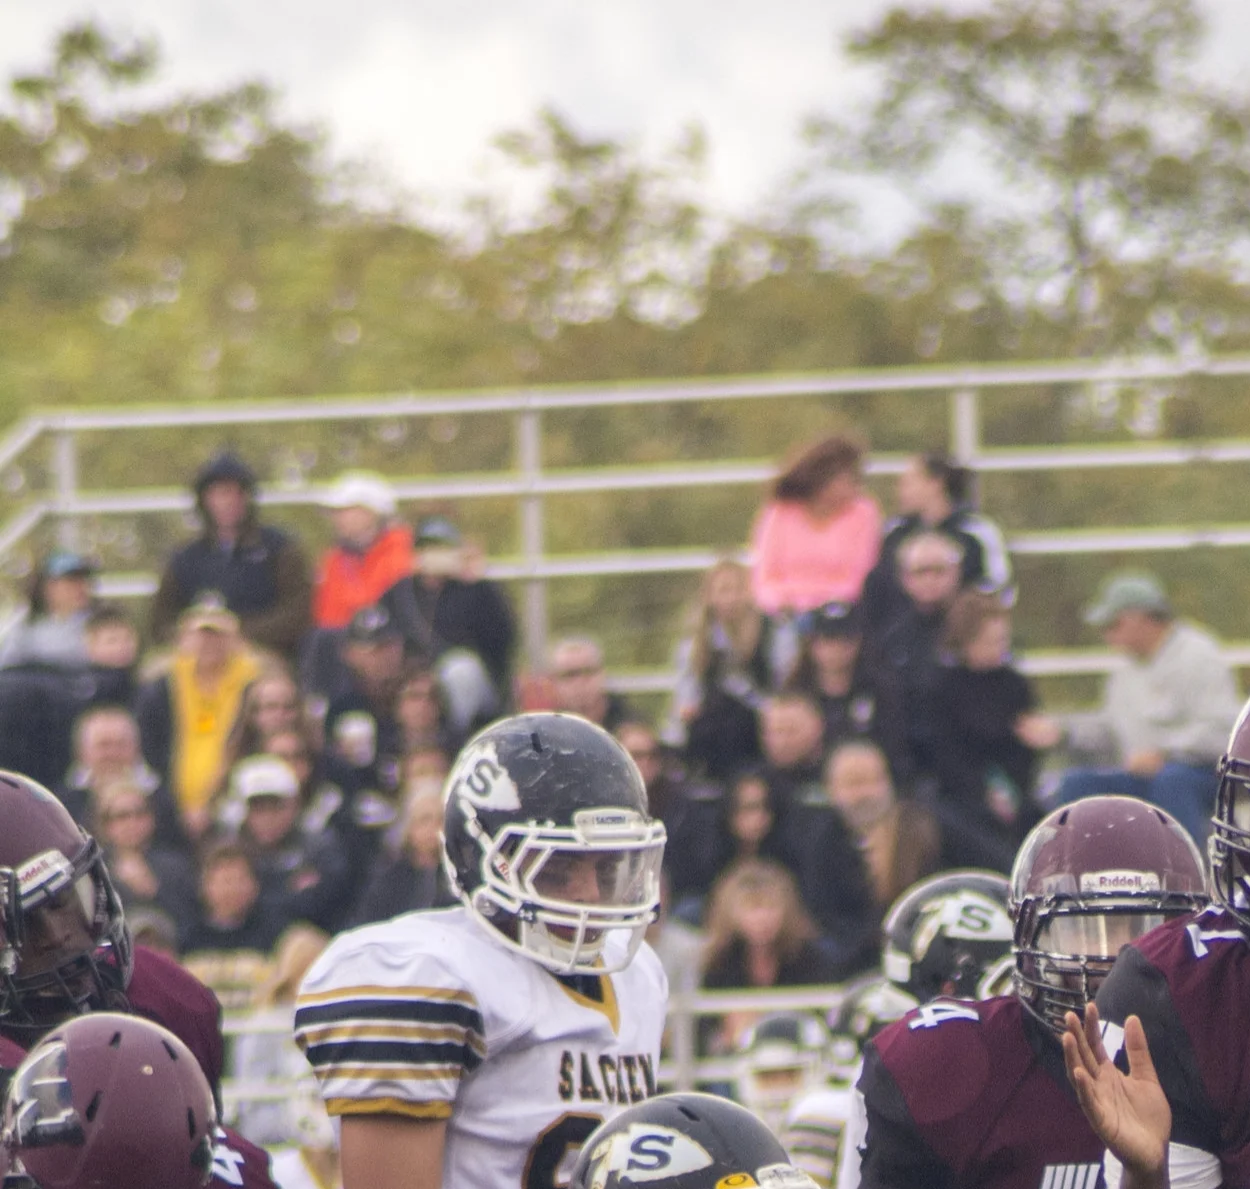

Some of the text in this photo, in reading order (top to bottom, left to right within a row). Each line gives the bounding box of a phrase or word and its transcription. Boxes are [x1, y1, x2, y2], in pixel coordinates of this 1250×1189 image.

[466, 758, 500, 797] S
[1100, 876, 1142, 889] Riddell
[956, 903, 994, 933] S
[909, 1003, 980, 1031] 4
[627, 1134, 674, 1171] S
